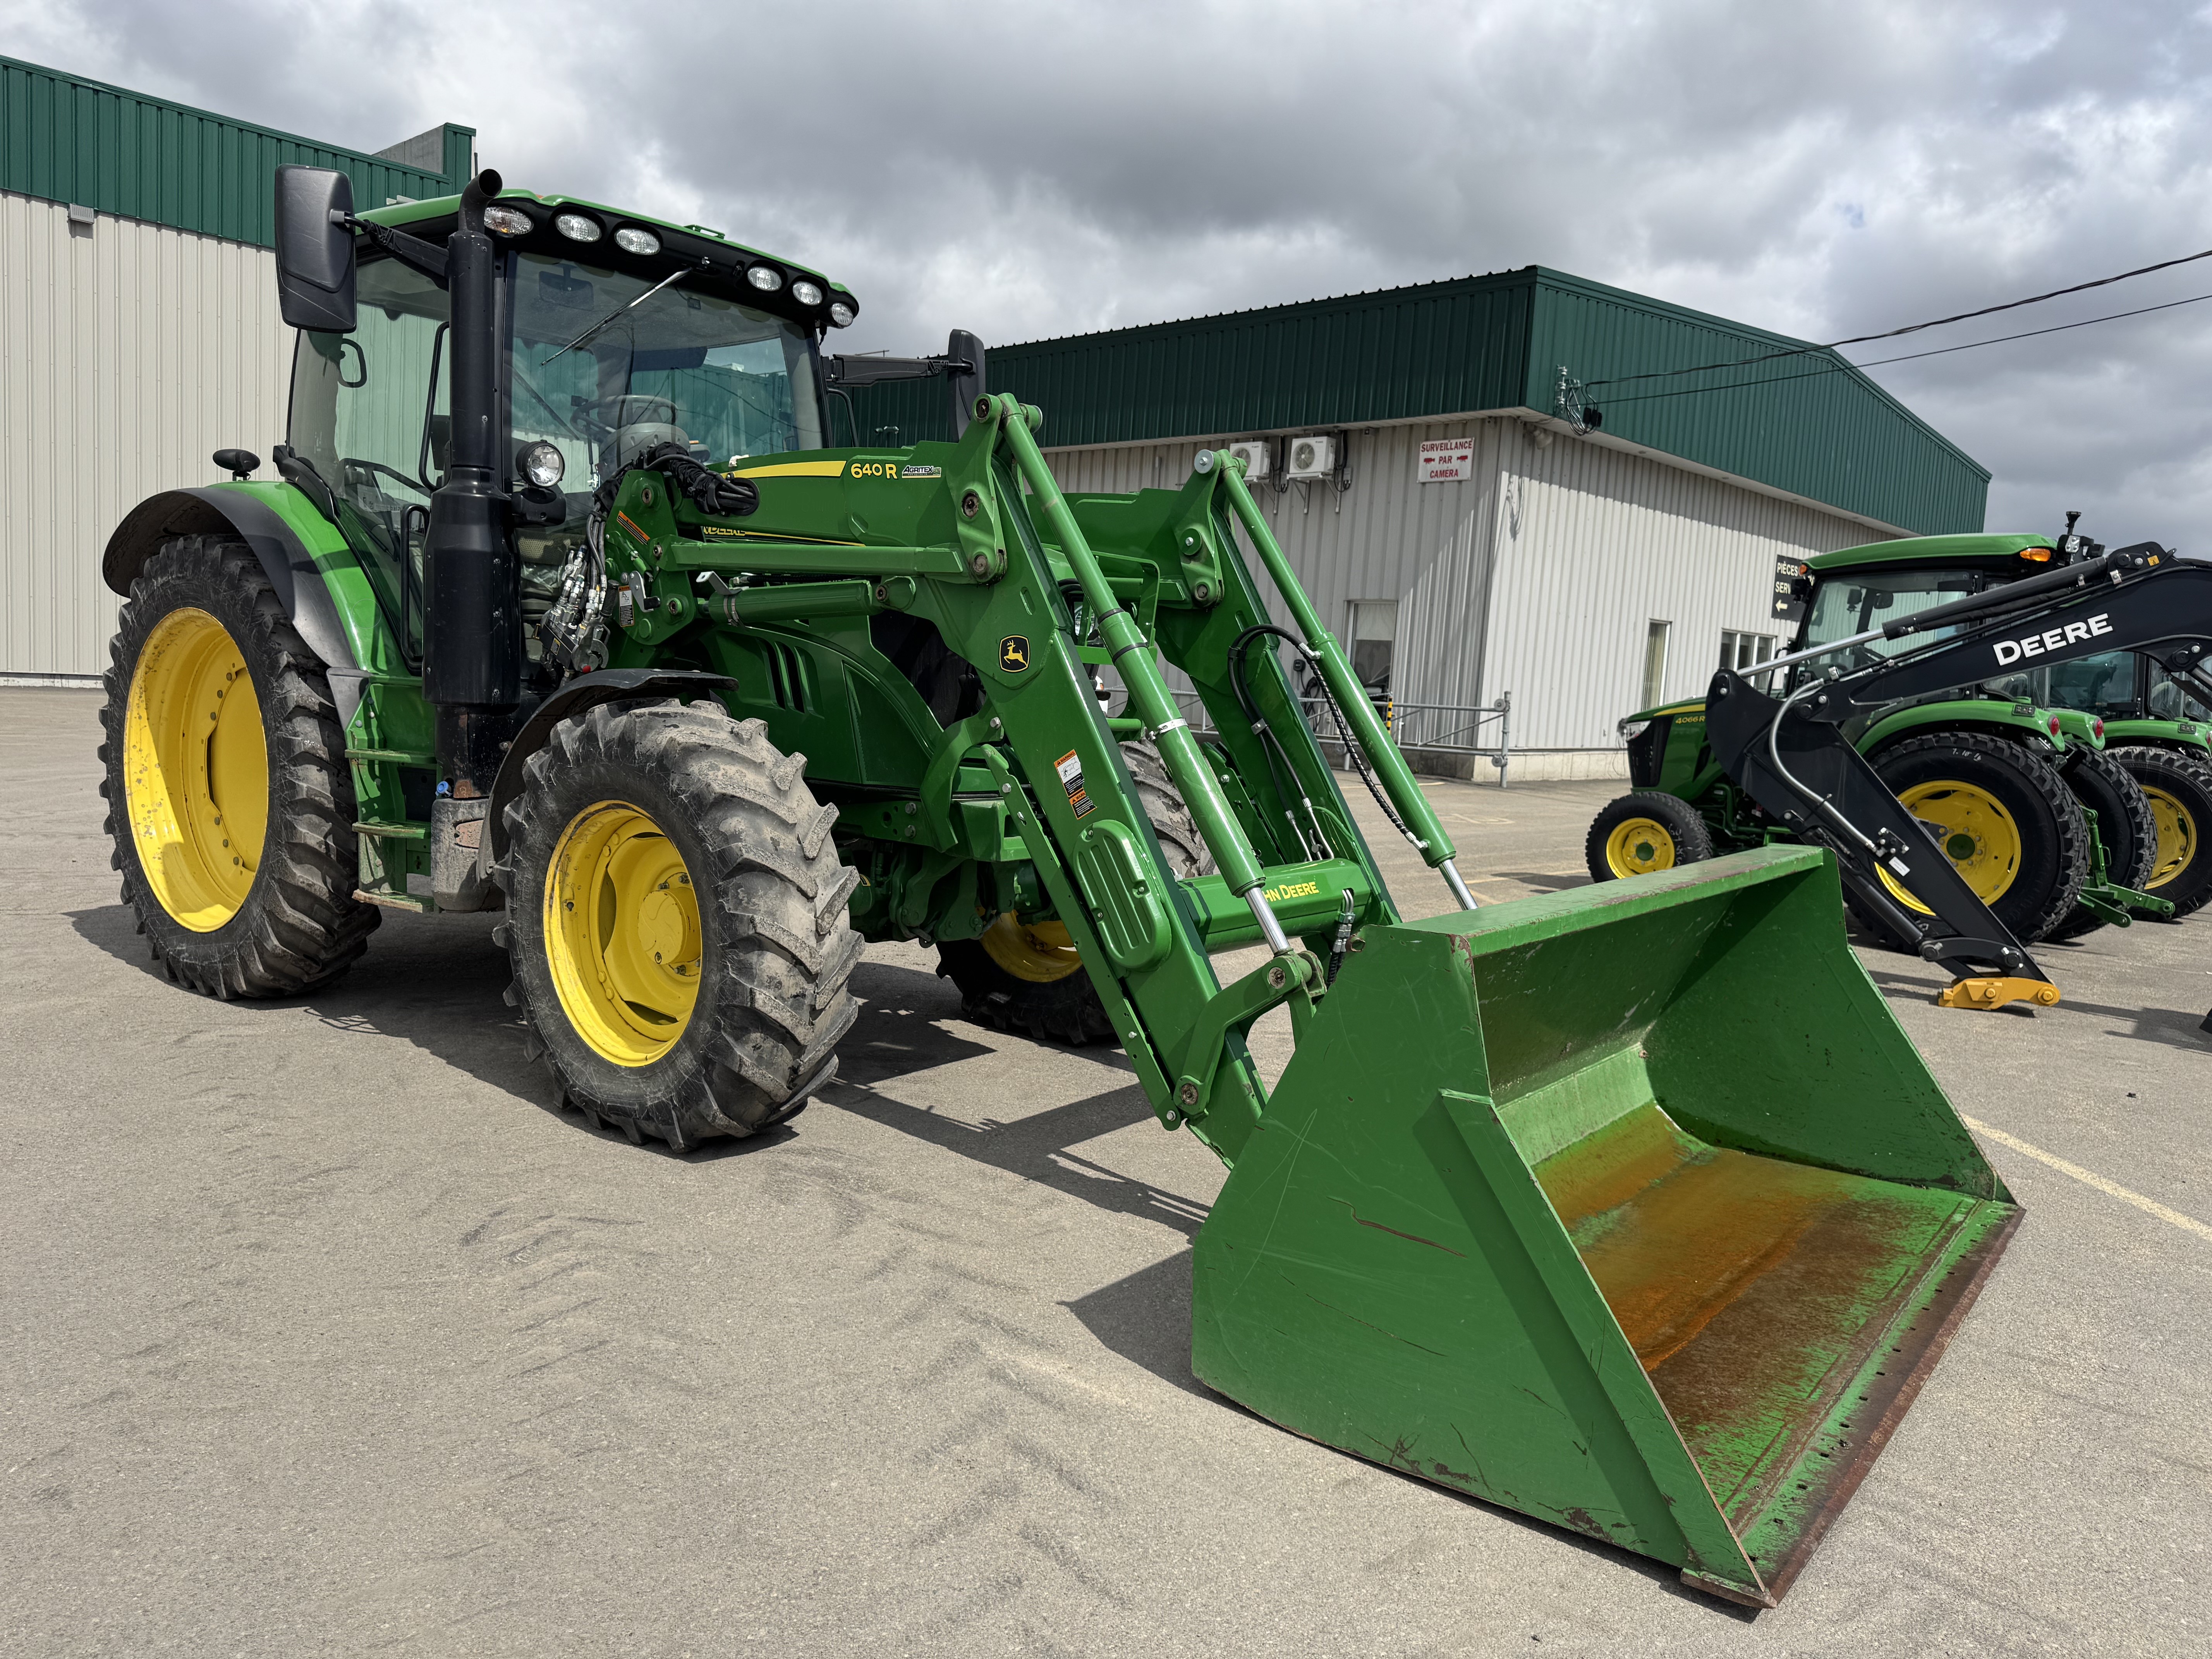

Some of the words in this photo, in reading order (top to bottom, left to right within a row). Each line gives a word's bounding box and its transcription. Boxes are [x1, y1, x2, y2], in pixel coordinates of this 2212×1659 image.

[1421, 440, 1472, 452] SURVEILLANCE
[1438, 455, 1453, 464] PAR
[1777, 561, 1798, 577] PIÈCES
[1775, 581, 1791, 595] SERV
[1992, 613, 2113, 666] DEERE
[1262, 888, 1281, 902] HN
[1279, 881, 1320, 899] DEERE
